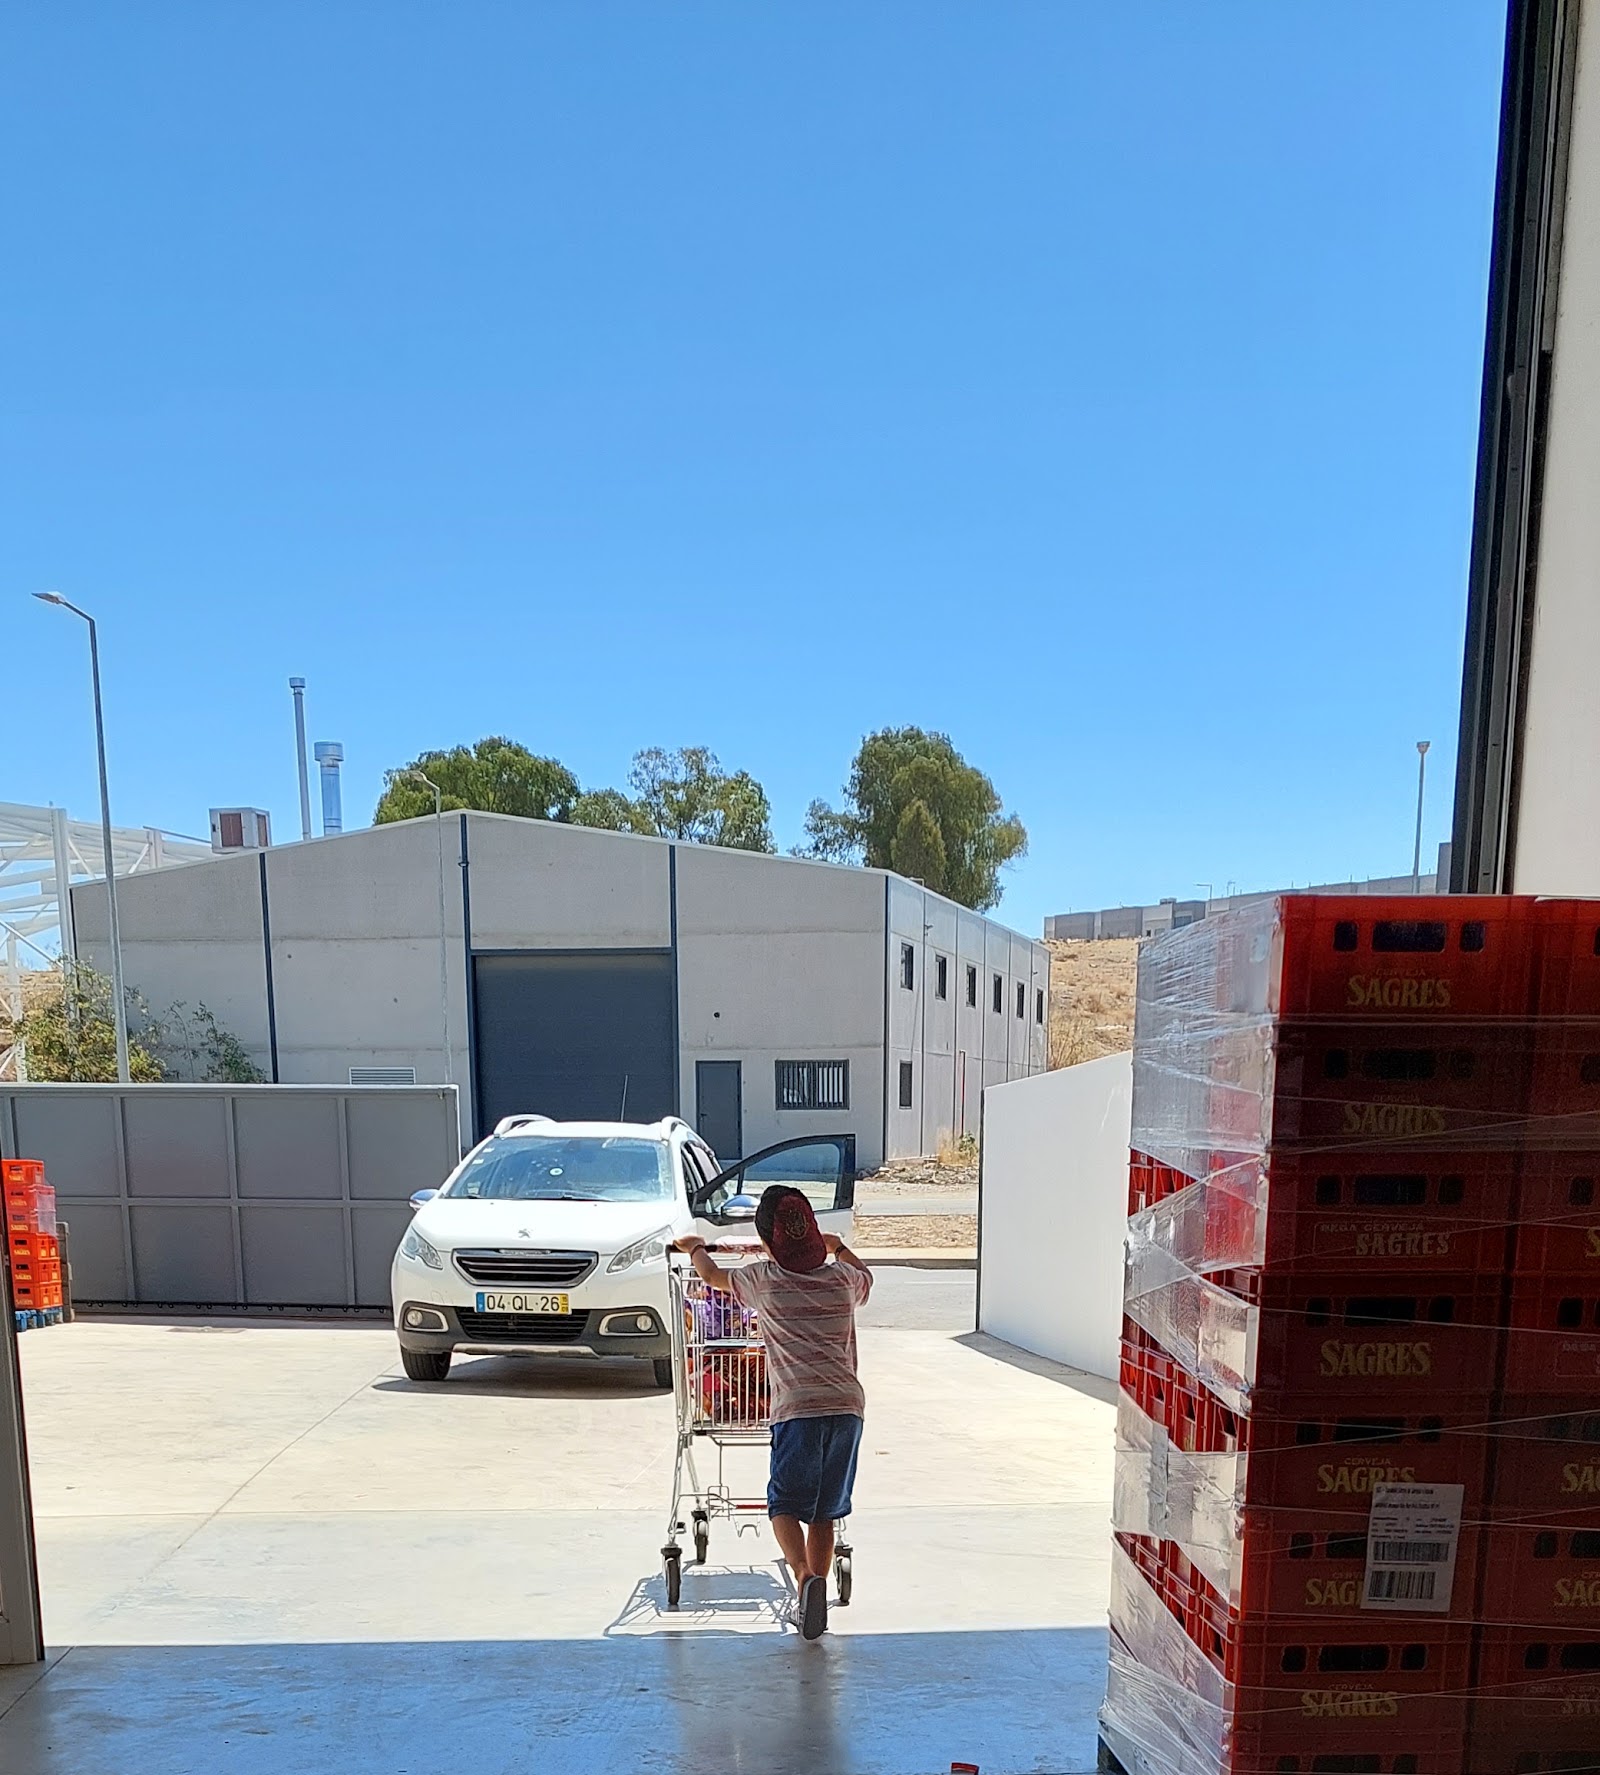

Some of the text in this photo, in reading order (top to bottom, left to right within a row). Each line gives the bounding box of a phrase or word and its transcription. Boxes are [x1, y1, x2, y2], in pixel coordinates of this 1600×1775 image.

[1347, 975, 1451, 1008] SAGRES
[1343, 1104, 1447, 1134] SAGRES
[1355, 1232, 1450, 1255] SAGRES
[1320, 1339, 1432, 1376] SAGRES
[1301, 1690, 1398, 1718] SAGRES
